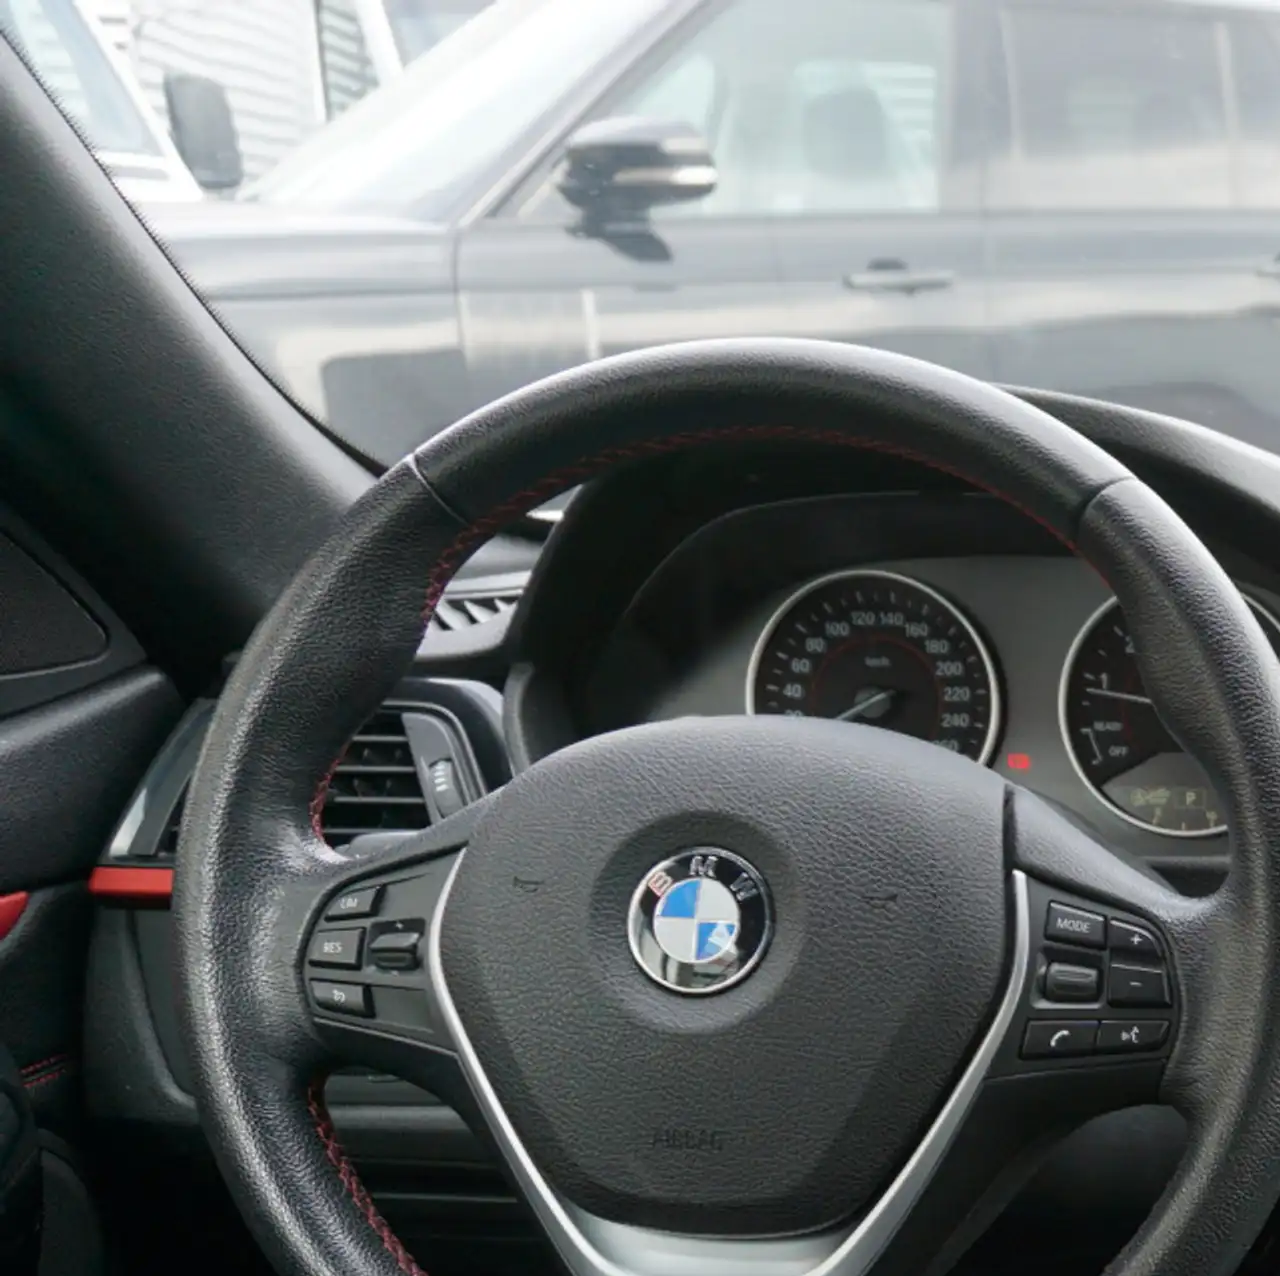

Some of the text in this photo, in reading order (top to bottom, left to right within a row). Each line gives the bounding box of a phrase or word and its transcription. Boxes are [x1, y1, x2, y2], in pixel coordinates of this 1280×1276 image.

[850, 611, 876, 626] 120
[878, 611, 905, 626] 140
[824, 621, 851, 637] 100
[904, 622, 929, 638] 160
[805, 637, 826, 653] 80
[923, 638, 949, 654] 180
[790, 659, 812, 674] 60
[935, 661, 964, 676] 200
[1100, 672, 1109, 691] 1
[782, 683, 804, 698] 40
[943, 685, 971, 701] 220
[941, 713, 968, 728] 240
[1185, 791, 1197, 806] P
[647, 855, 757, 900] BMW
[1056, 917, 1091, 933] MODE
[323, 941, 342, 953] RES
